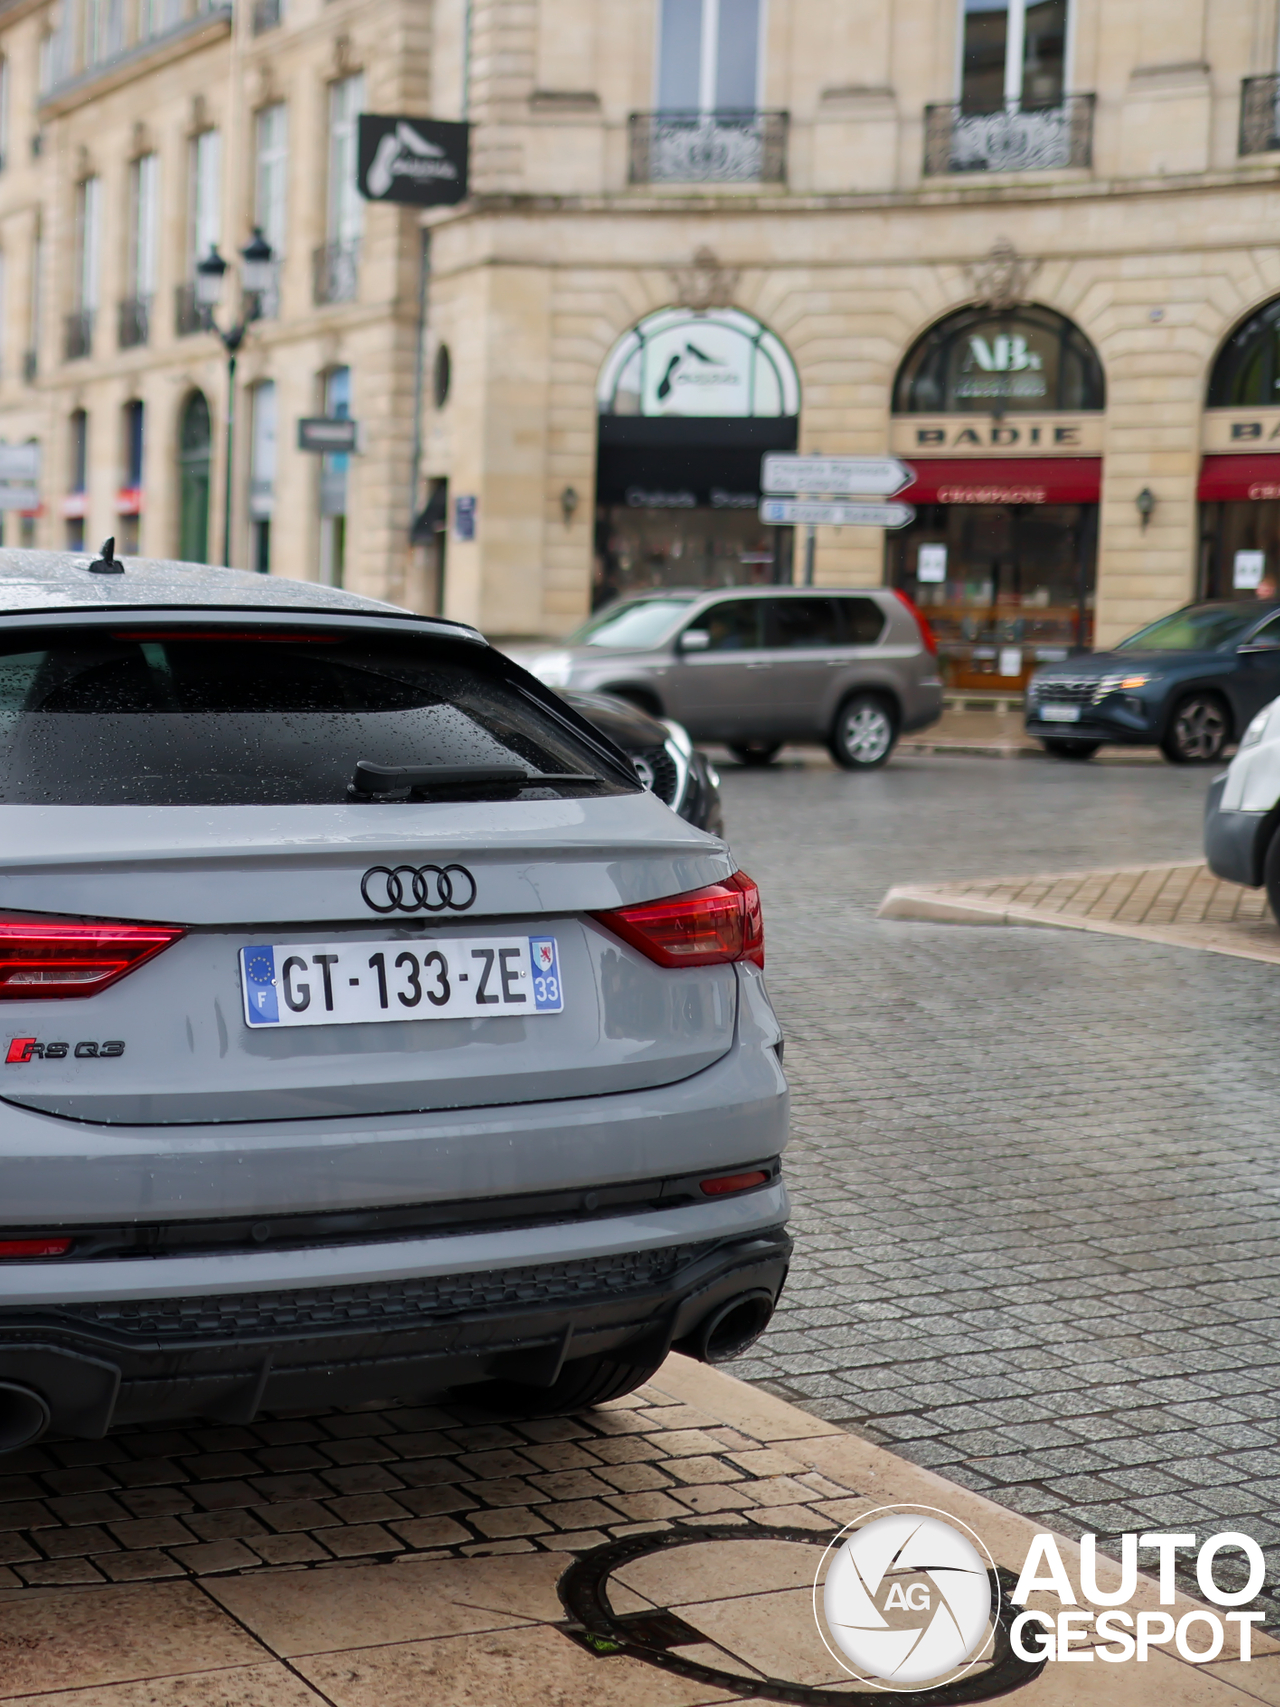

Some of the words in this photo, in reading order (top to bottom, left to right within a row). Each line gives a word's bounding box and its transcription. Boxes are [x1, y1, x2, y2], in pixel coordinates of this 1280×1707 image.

[916, 427, 1082, 447] BADIE
[937, 485, 1047, 504] CHAMPAGNE
[282, 947, 527, 1013] GT-133-ZE
[534, 976, 559, 1002] 33
[257, 991, 267, 1008] F
[20, 1042, 70, 1059] RS
[74, 1040, 126, 1059] Q3
